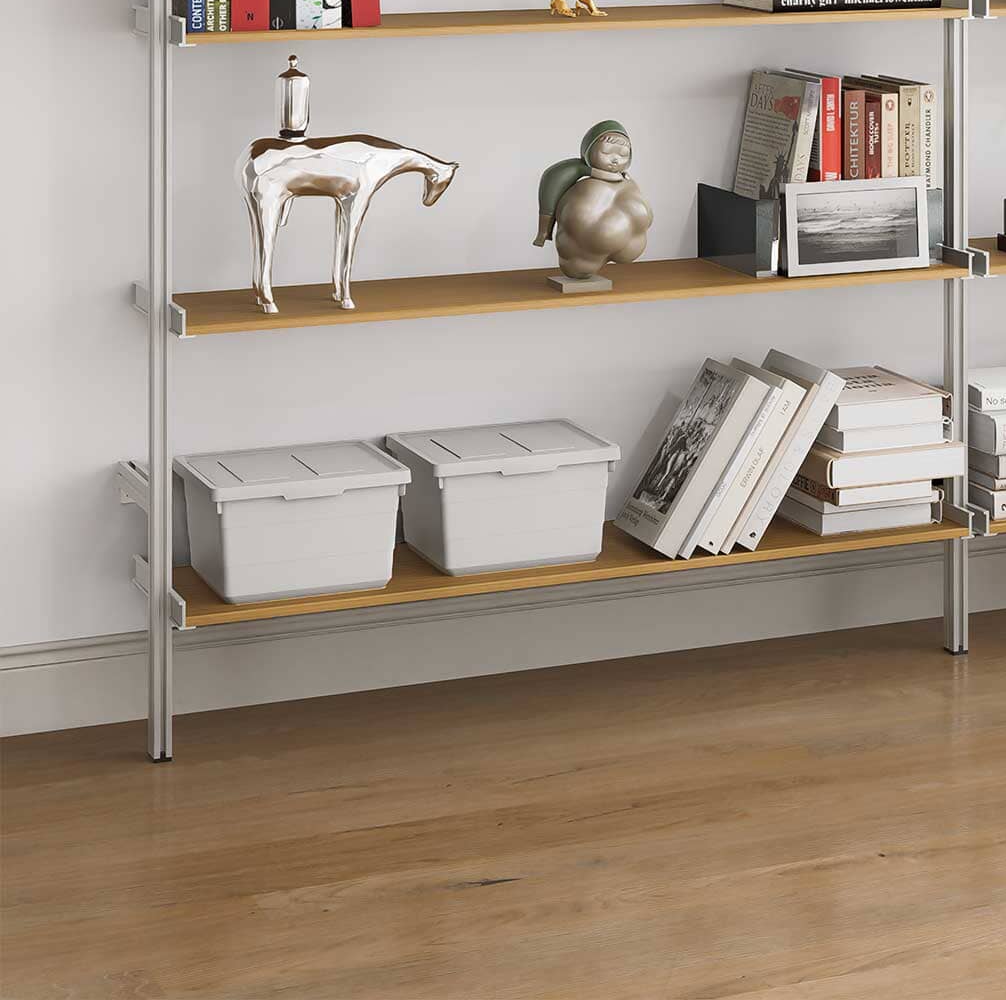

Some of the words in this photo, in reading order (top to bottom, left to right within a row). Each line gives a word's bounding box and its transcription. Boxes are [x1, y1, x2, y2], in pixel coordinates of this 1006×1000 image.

[219, 5, 227, 31] OTHER
[849, 101, 859, 178] CHITEKTUR
[986, 396, 998, 406] No
